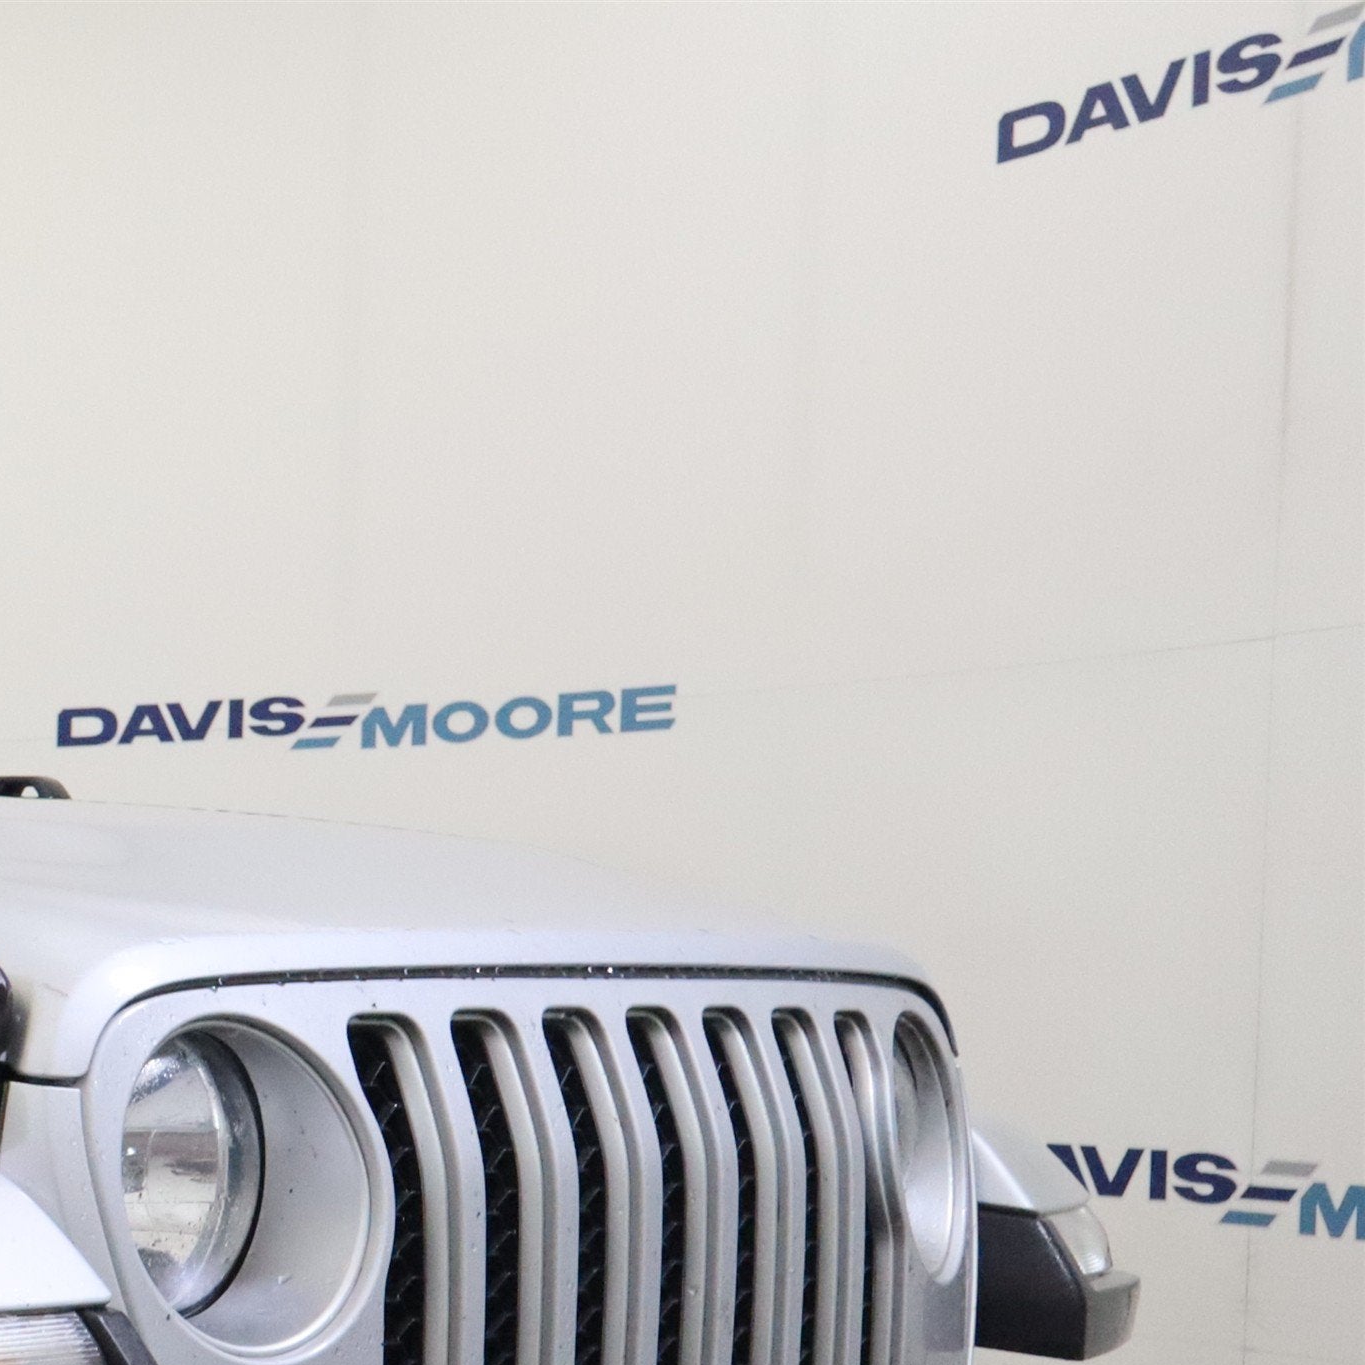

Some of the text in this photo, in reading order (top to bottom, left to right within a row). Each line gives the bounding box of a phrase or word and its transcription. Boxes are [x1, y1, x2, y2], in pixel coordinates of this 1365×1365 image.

[997, 33, 1282, 164] DAVIS
[56, 684, 678, 749] DAVIS MOORE
[1046, 1143, 1238, 1205] VIS
